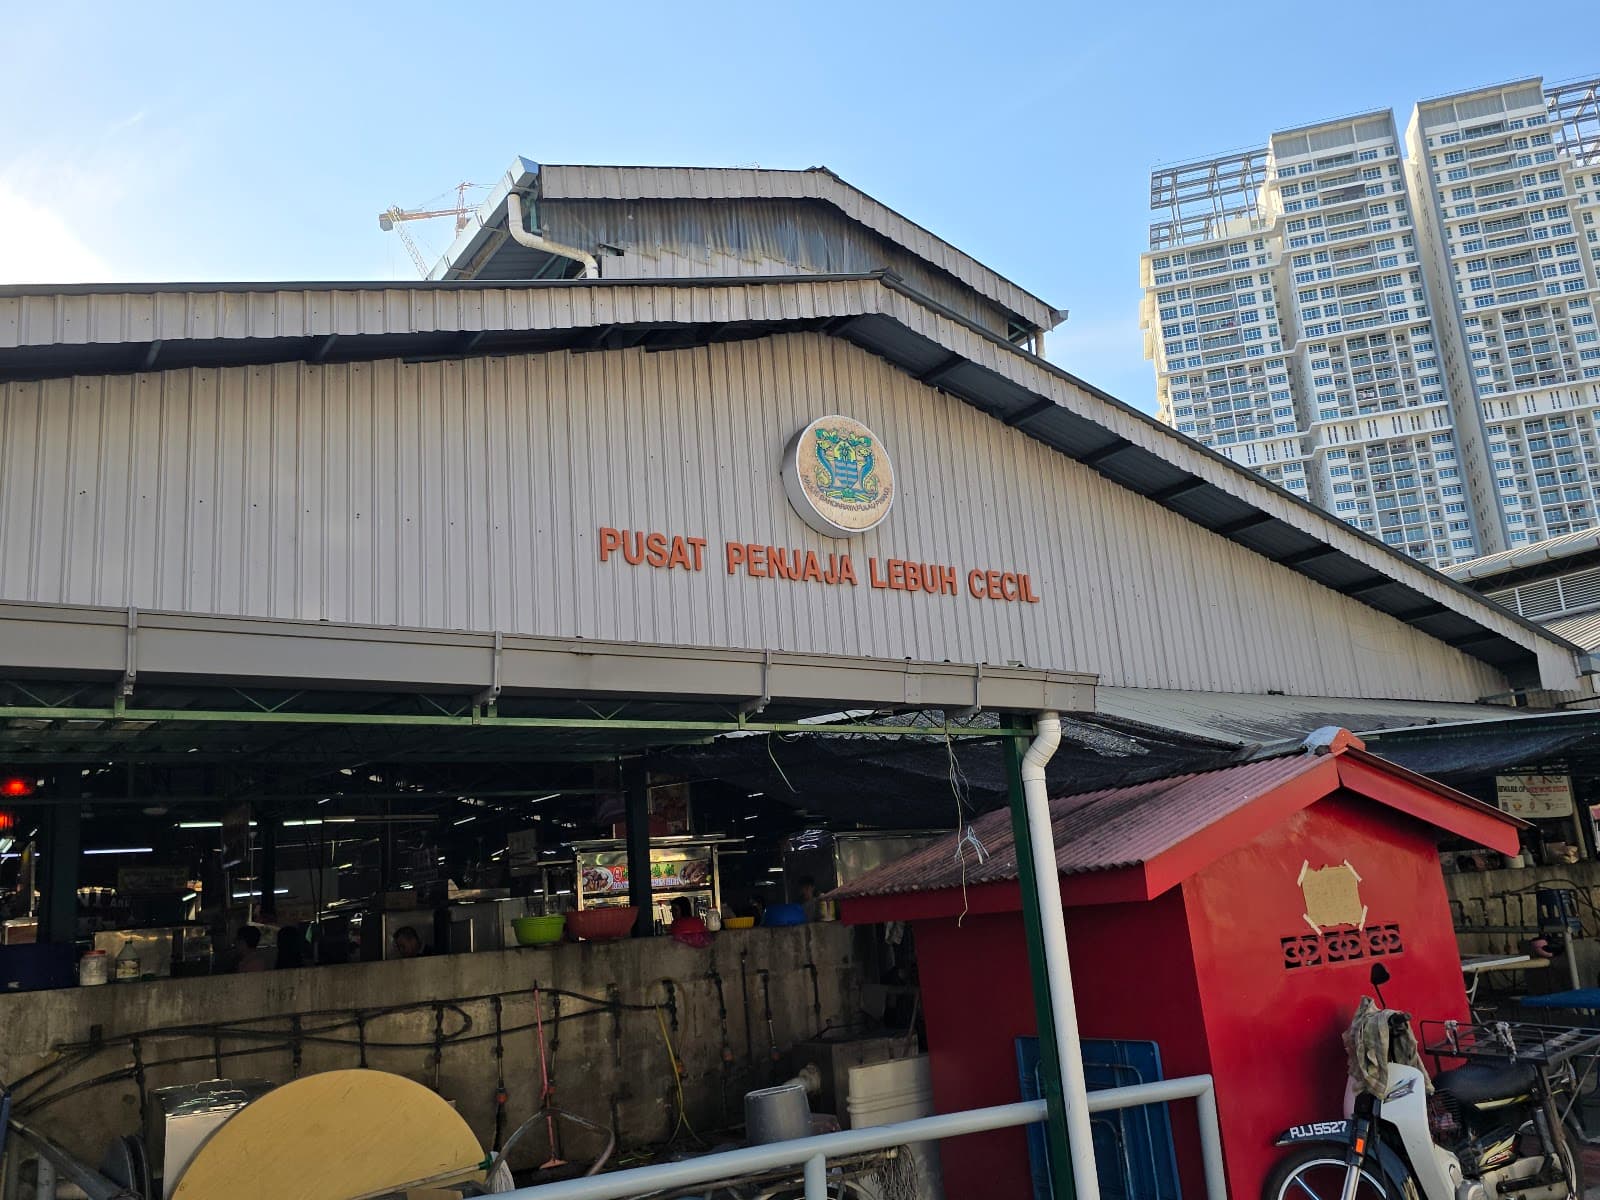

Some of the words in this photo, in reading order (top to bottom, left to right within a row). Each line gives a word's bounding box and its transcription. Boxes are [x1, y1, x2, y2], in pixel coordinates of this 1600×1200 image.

[599, 527, 708, 572] PUSAT
[726, 541, 858, 586] PENJAJA
[868, 557, 958, 596] LEBUH
[968, 567, 1040, 603] CECIL
